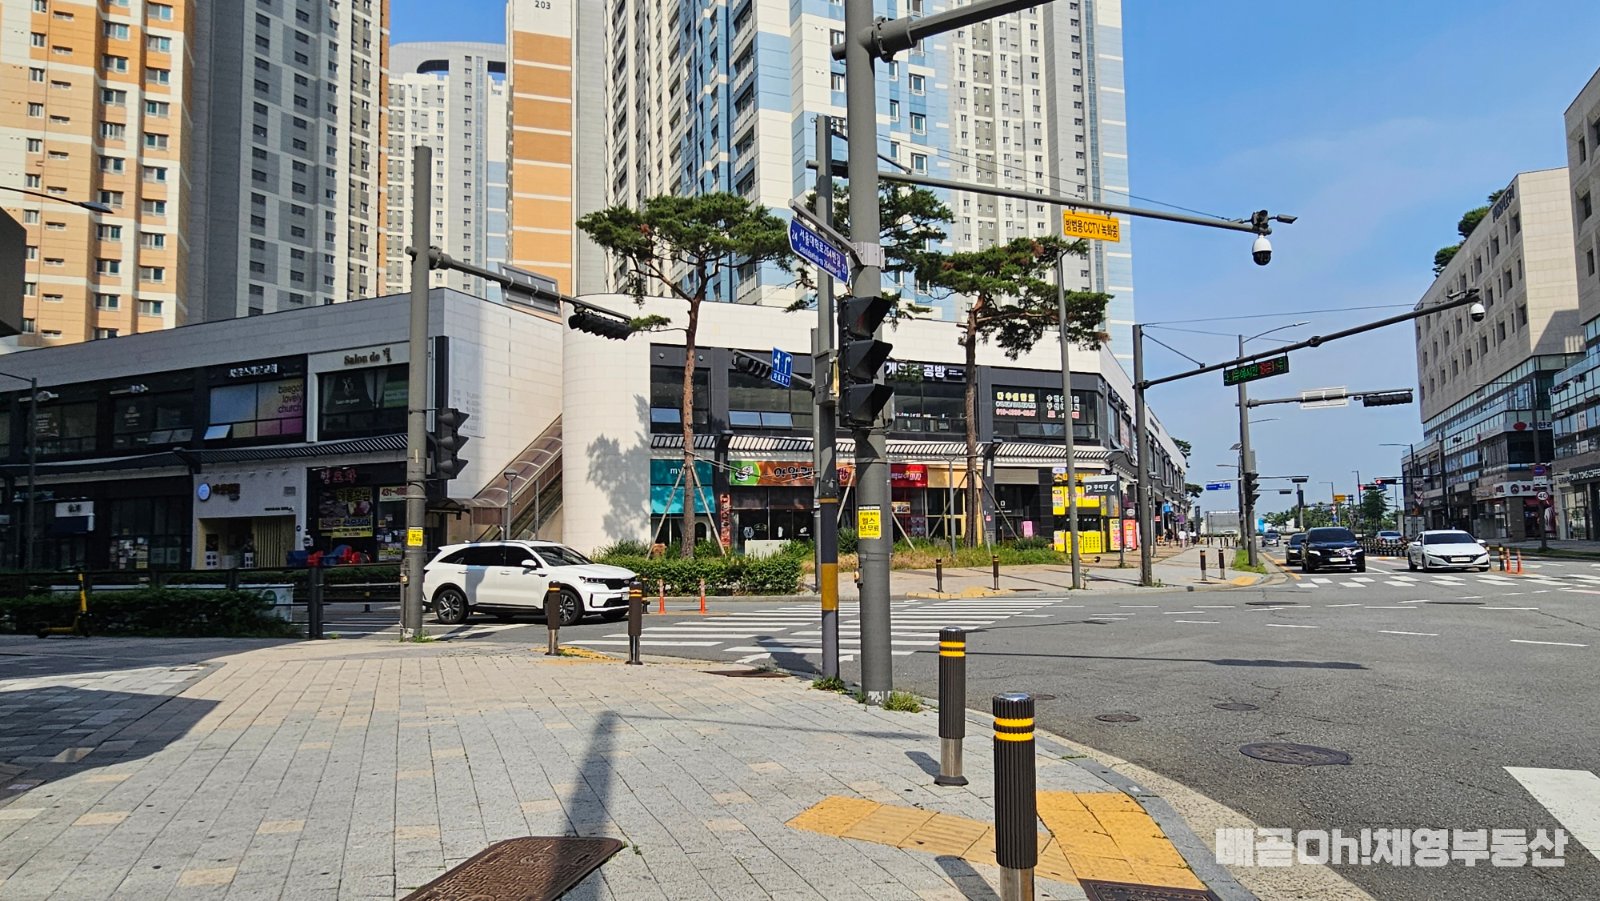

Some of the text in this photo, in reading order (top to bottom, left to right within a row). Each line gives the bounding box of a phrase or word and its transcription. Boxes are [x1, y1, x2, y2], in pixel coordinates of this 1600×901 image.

[535, 0, 551, 10] 203
[791, 229, 798, 242] 24
[344, 354, 367, 365] Salon
[370, 351, 380, 362] de
[923, 364, 946, 378] 공방
[1086, 485, 1092, 493] P
[1538, 492, 1547, 500] 40
